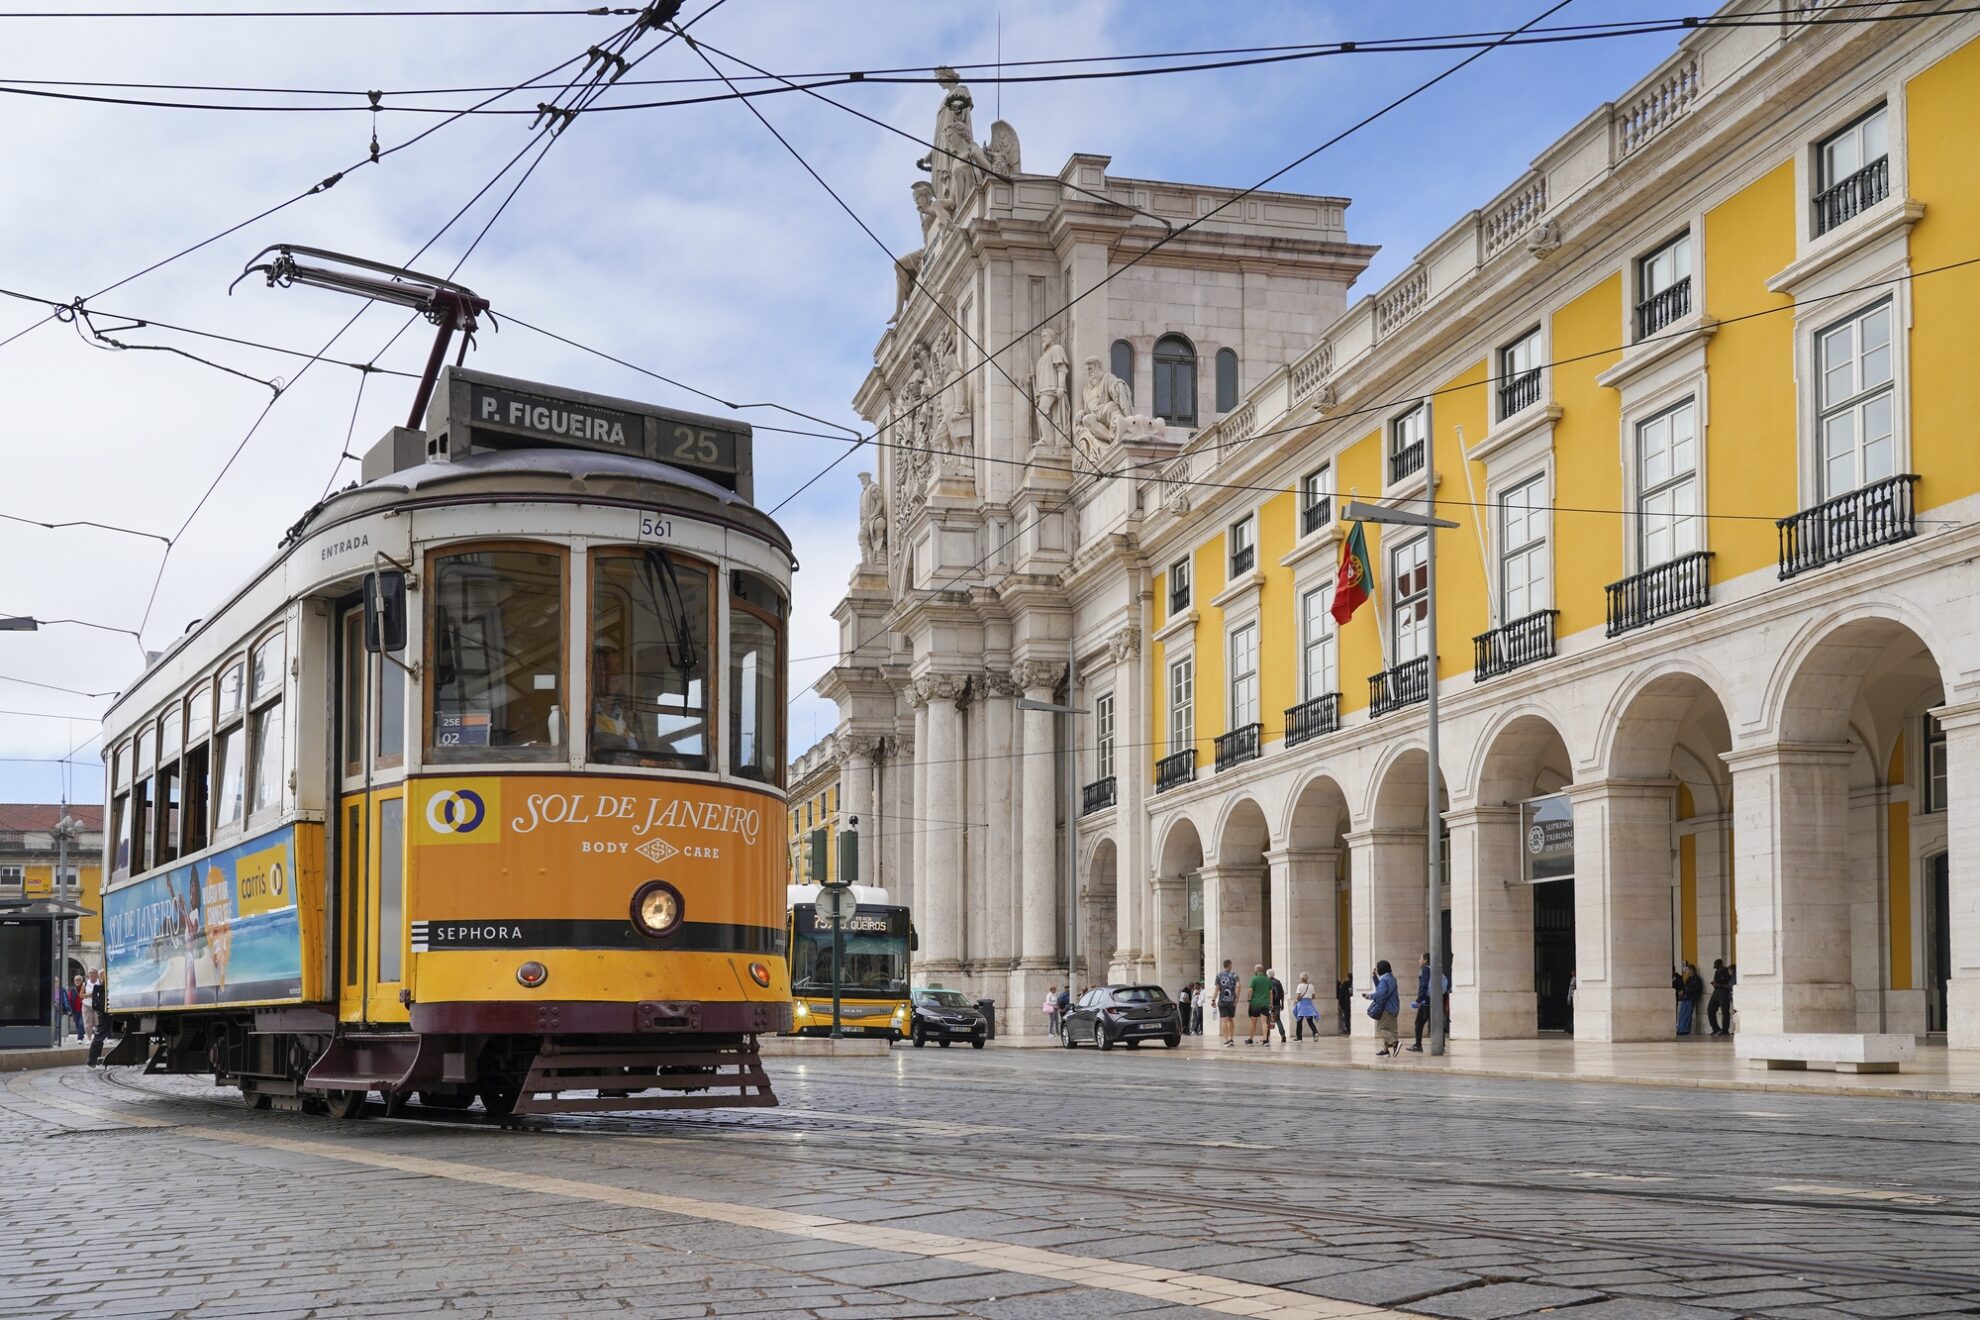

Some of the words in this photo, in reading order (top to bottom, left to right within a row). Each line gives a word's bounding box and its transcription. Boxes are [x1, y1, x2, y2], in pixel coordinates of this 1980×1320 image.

[481, 395, 500, 422] P.
[509, 401, 626, 446] FIGUEIRA
[673, 427, 719, 463] 25
[642, 518, 671, 538] 561
[321, 534, 369, 561] ENTRADA
[443, 718, 461, 727] 25E
[442, 733, 460, 745] 02
[511, 794, 589, 833] SOL
[594, 795, 636, 818] DE
[632, 798, 760, 845] JANEIRO
[1545, 820, 1572, 830] SUPREMO
[1545, 831, 1573, 842] TRIBUNAL
[582, 842, 629, 853] BODY
[684, 846, 720, 858] CARE
[1546, 844, 1555, 853] DE
[1555, 841, 1574, 852] JUSTIÇ
[241, 865, 266, 899] carris
[109, 914, 125, 962] SOL
[124, 910, 135, 938] DE
[133, 896, 180, 957] JANEIRO
[437, 926, 522, 940] SEPHORA
[850, 921, 886, 931] QUEIROS
